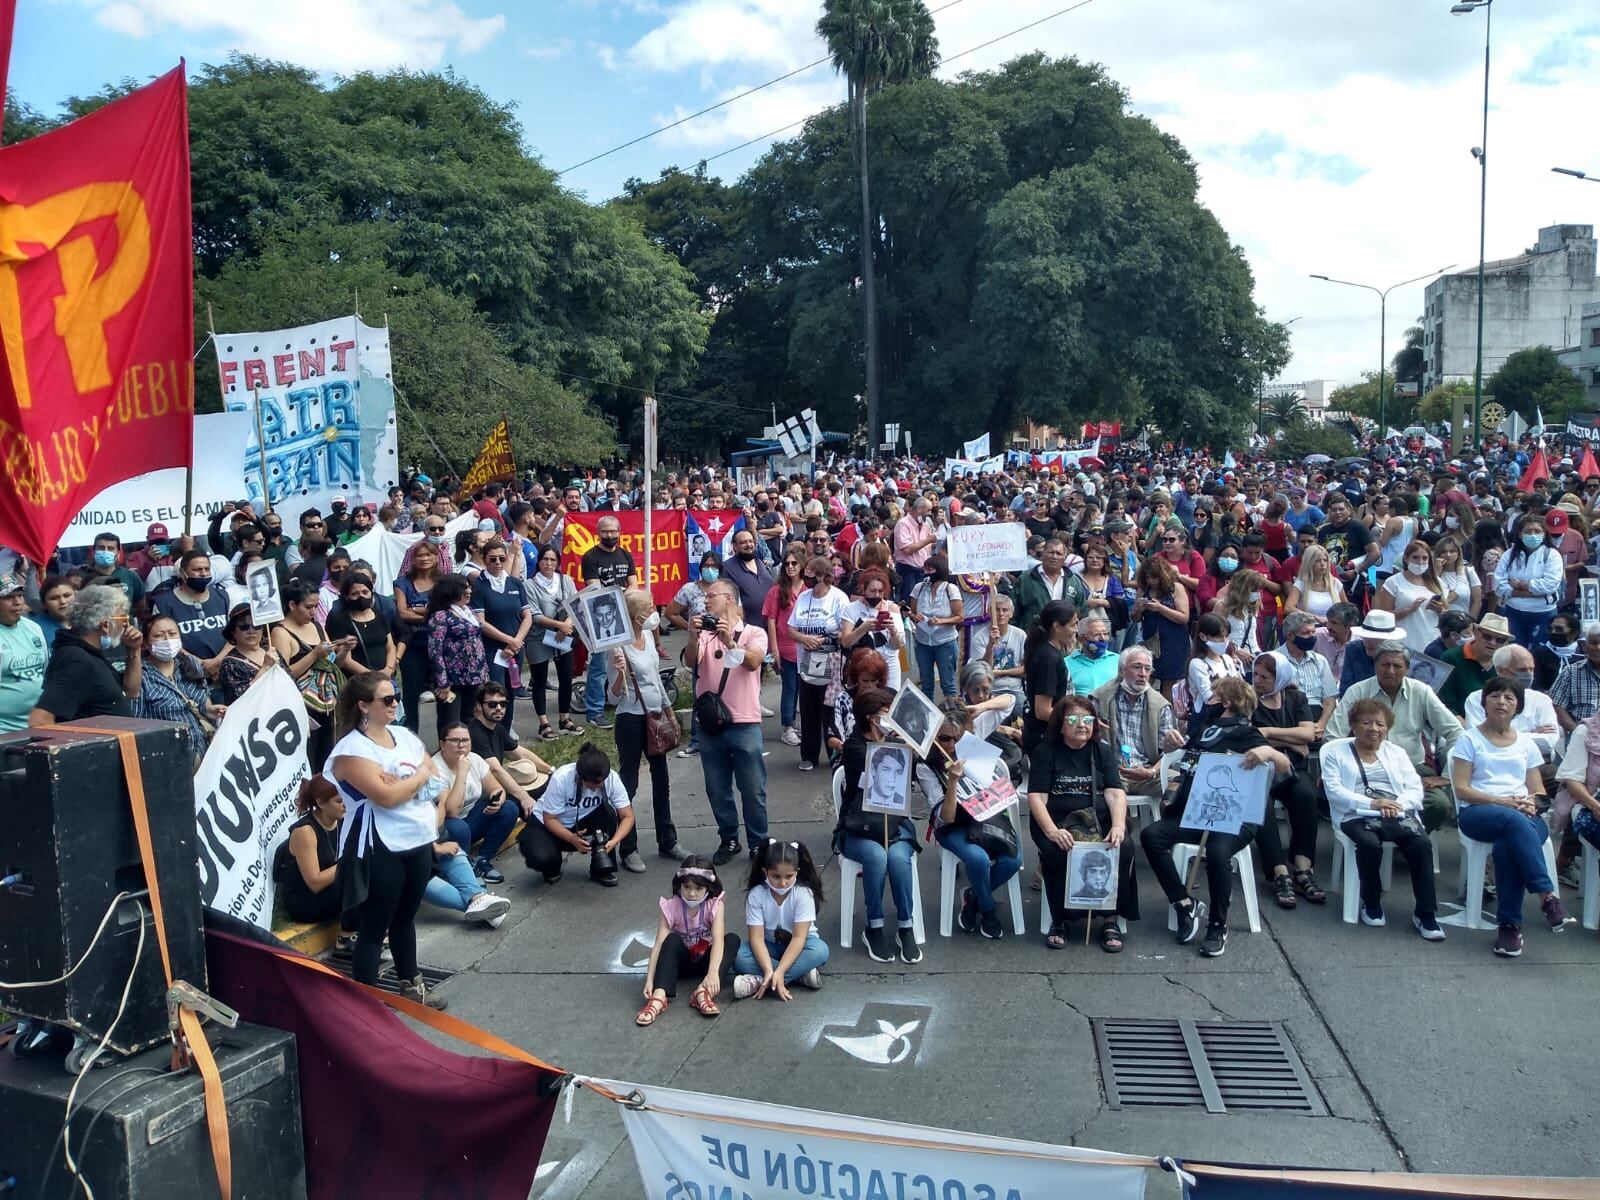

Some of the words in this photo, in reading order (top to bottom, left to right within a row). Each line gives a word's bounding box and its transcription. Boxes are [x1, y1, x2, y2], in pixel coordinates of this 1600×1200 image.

[227, 379, 356, 447] ATR
[132, 508, 153, 523] ES
[157, 506, 180, 521] EL
[951, 530, 985, 544] KUKY
[178, 614, 227, 634] UPCN
[258, 806, 289, 849] acional
[241, 876, 255, 895] de
